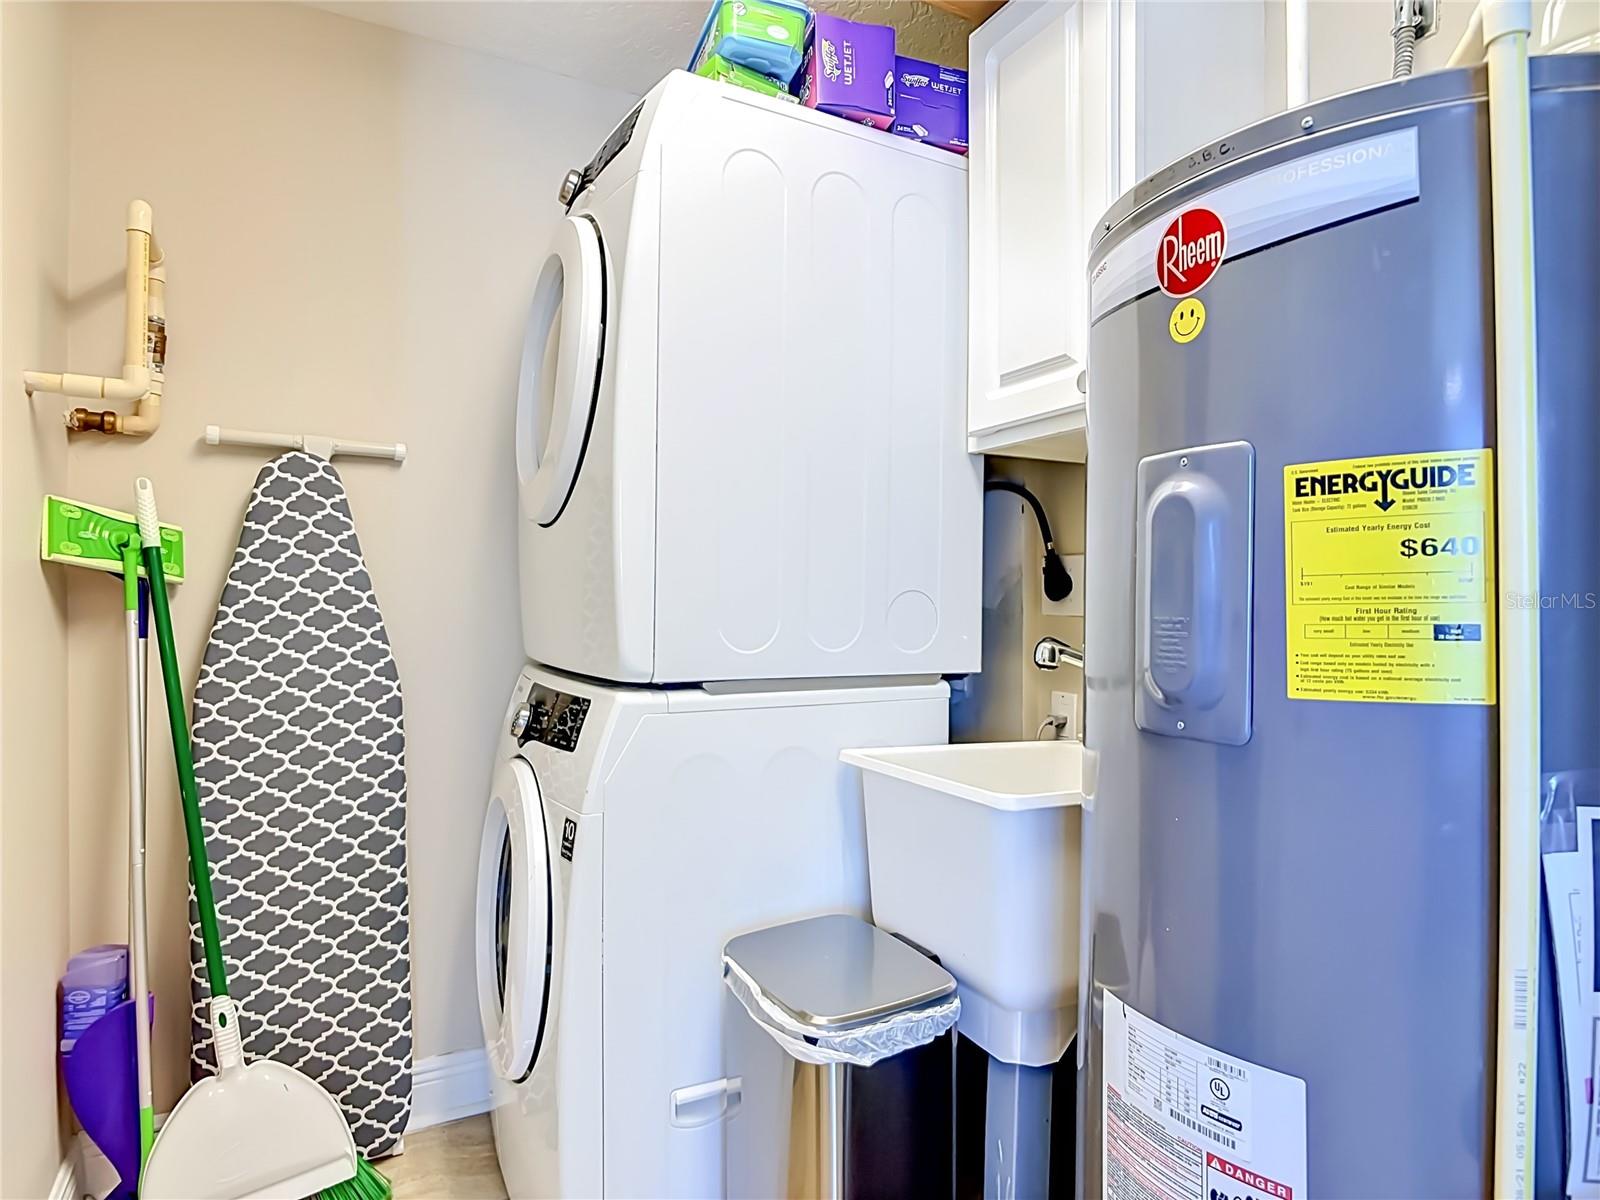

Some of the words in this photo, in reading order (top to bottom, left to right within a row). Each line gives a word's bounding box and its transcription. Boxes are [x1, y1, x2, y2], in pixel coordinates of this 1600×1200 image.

[822, 38, 842, 82] Swiffer
[843, 40, 853, 85] WETJET
[901, 74, 930, 87] Swiffer
[931, 81, 962, 95] WETJET
[1163, 215, 1222, 287] Rheem
[1294, 463, 1476, 499] ENERGYGUIDE
[1326, 525, 1360, 533] Estimated
[1362, 524, 1384, 532] Yearly
[1387, 523, 1412, 531] Energy
[1400, 536, 1479, 559] $640
[1394, 607, 1417, 615] Rating
[1225, 1163, 1287, 1198] DANGER
